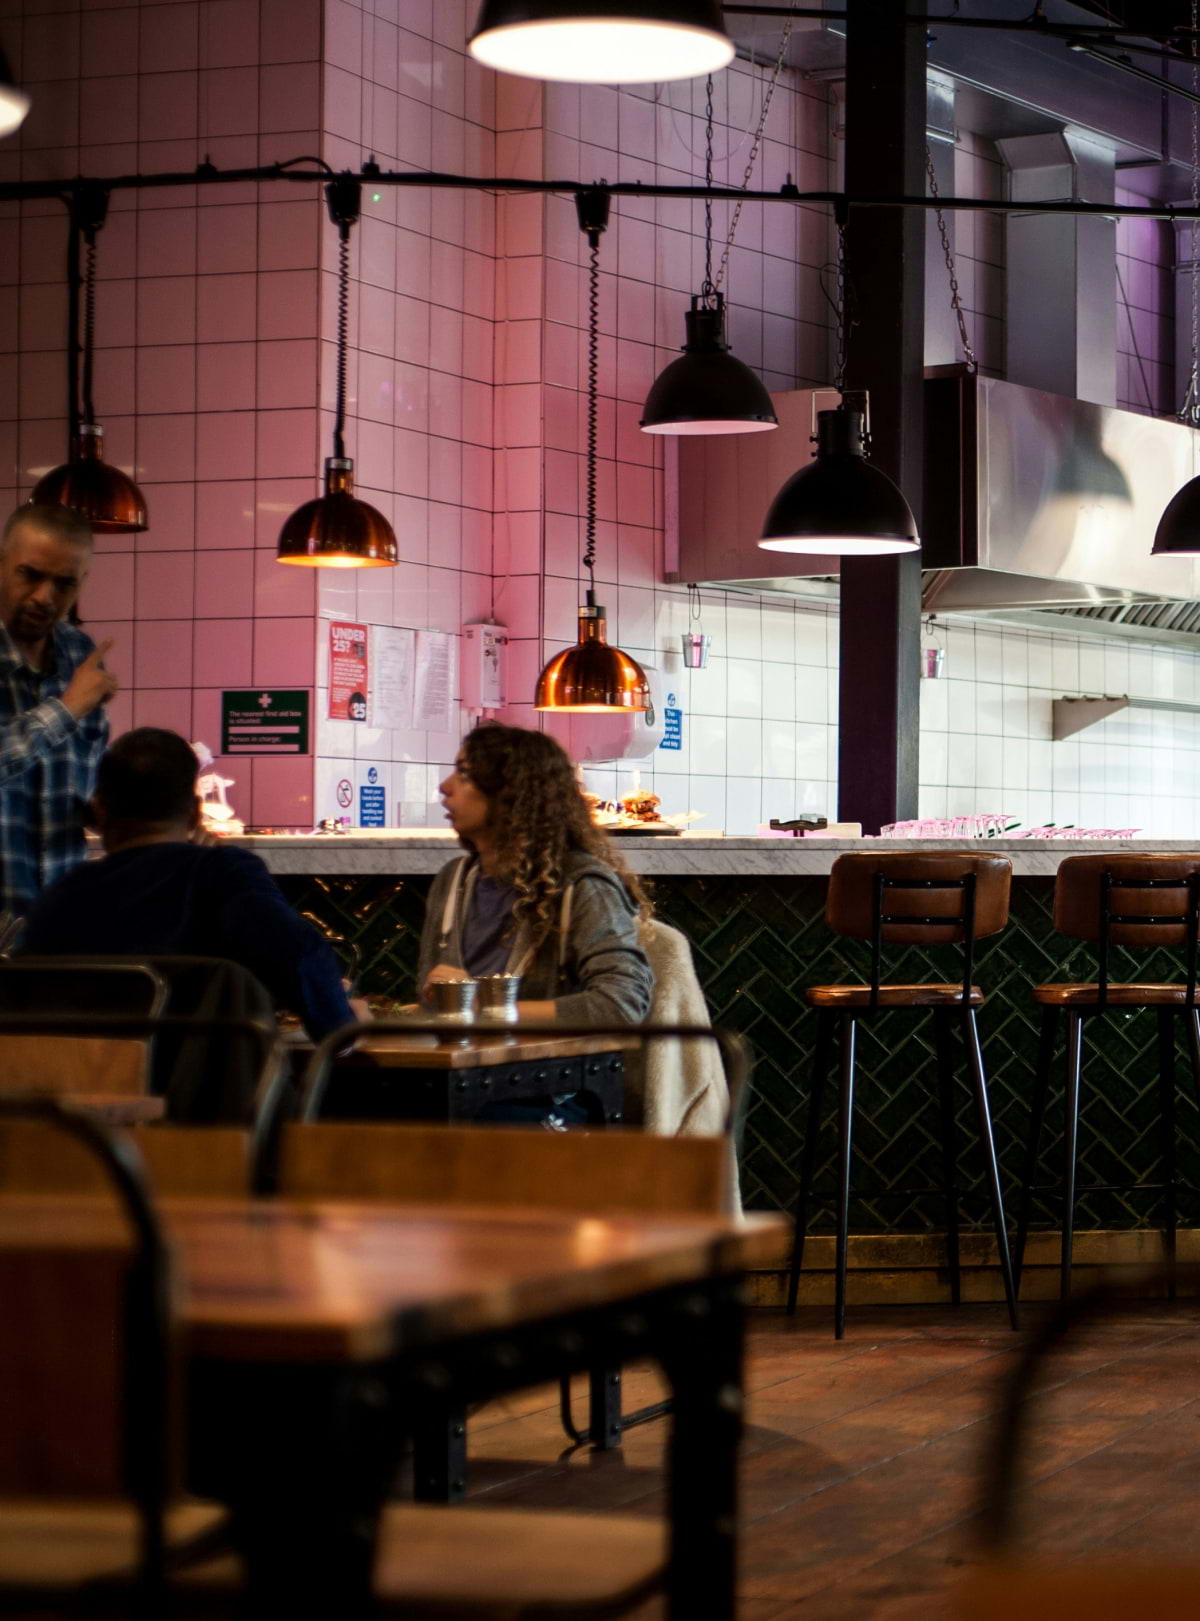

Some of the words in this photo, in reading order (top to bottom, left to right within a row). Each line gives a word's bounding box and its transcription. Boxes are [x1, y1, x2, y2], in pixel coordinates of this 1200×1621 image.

[331, 626, 365, 642] UNDER
[333, 640, 351, 653] 25?
[352, 702, 366, 719] 25
